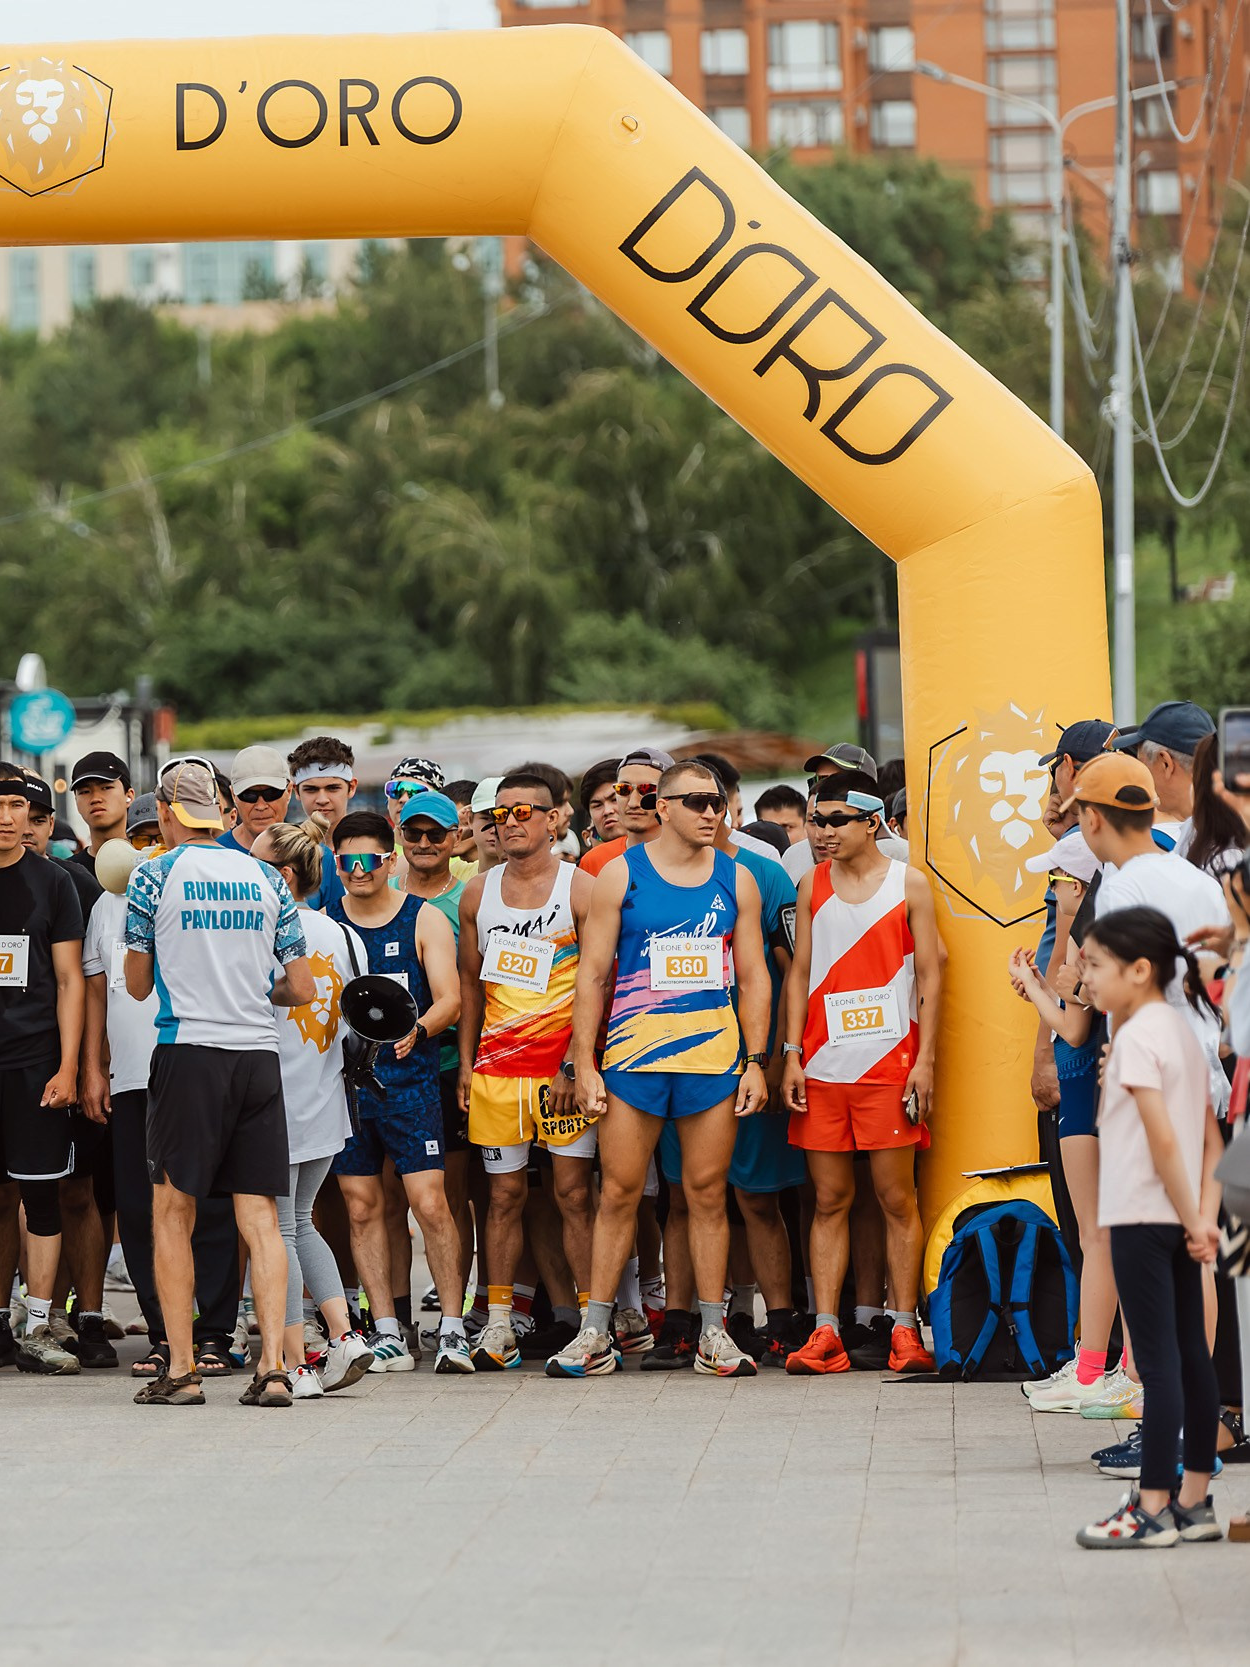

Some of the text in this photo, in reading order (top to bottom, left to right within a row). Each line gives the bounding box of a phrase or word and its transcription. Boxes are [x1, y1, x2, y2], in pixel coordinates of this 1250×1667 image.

[175, 75, 463, 152] D'ORO
[183, 881, 262, 902] RUNNING
[181, 909, 265, 931] PAVLODAR
[494, 938, 518, 948] LEONE
[656, 944, 682, 952] LEONE
[501, 953, 533, 975] 320
[670, 958, 704, 975] 360
[830, 997, 856, 1007] LEONE
[846, 1008, 879, 1029] 337
[541, 1117, 591, 1136] SPORTS
